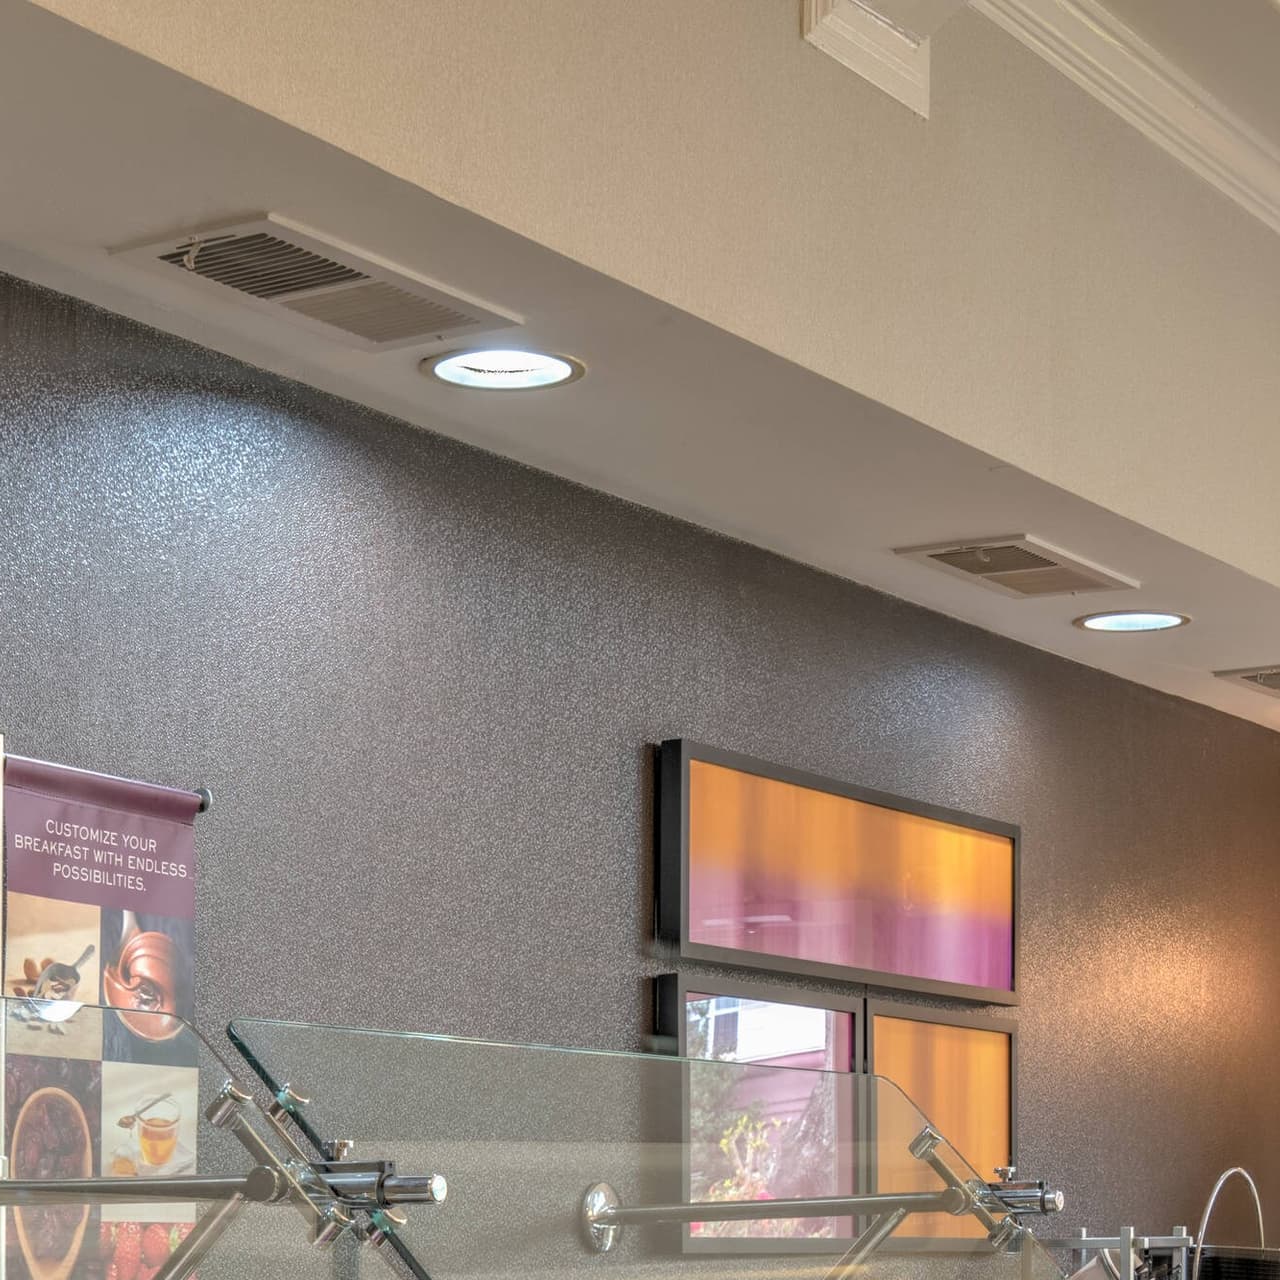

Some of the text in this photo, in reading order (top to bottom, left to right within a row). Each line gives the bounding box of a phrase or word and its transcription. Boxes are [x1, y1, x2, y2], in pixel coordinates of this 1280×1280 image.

[45, 819, 157, 853] CUSTOMIZE YOUR
[14, 834, 188, 878] BREAKFAST WITH ENDLESS
[53, 862, 147, 892] POSSIBILITIES.
